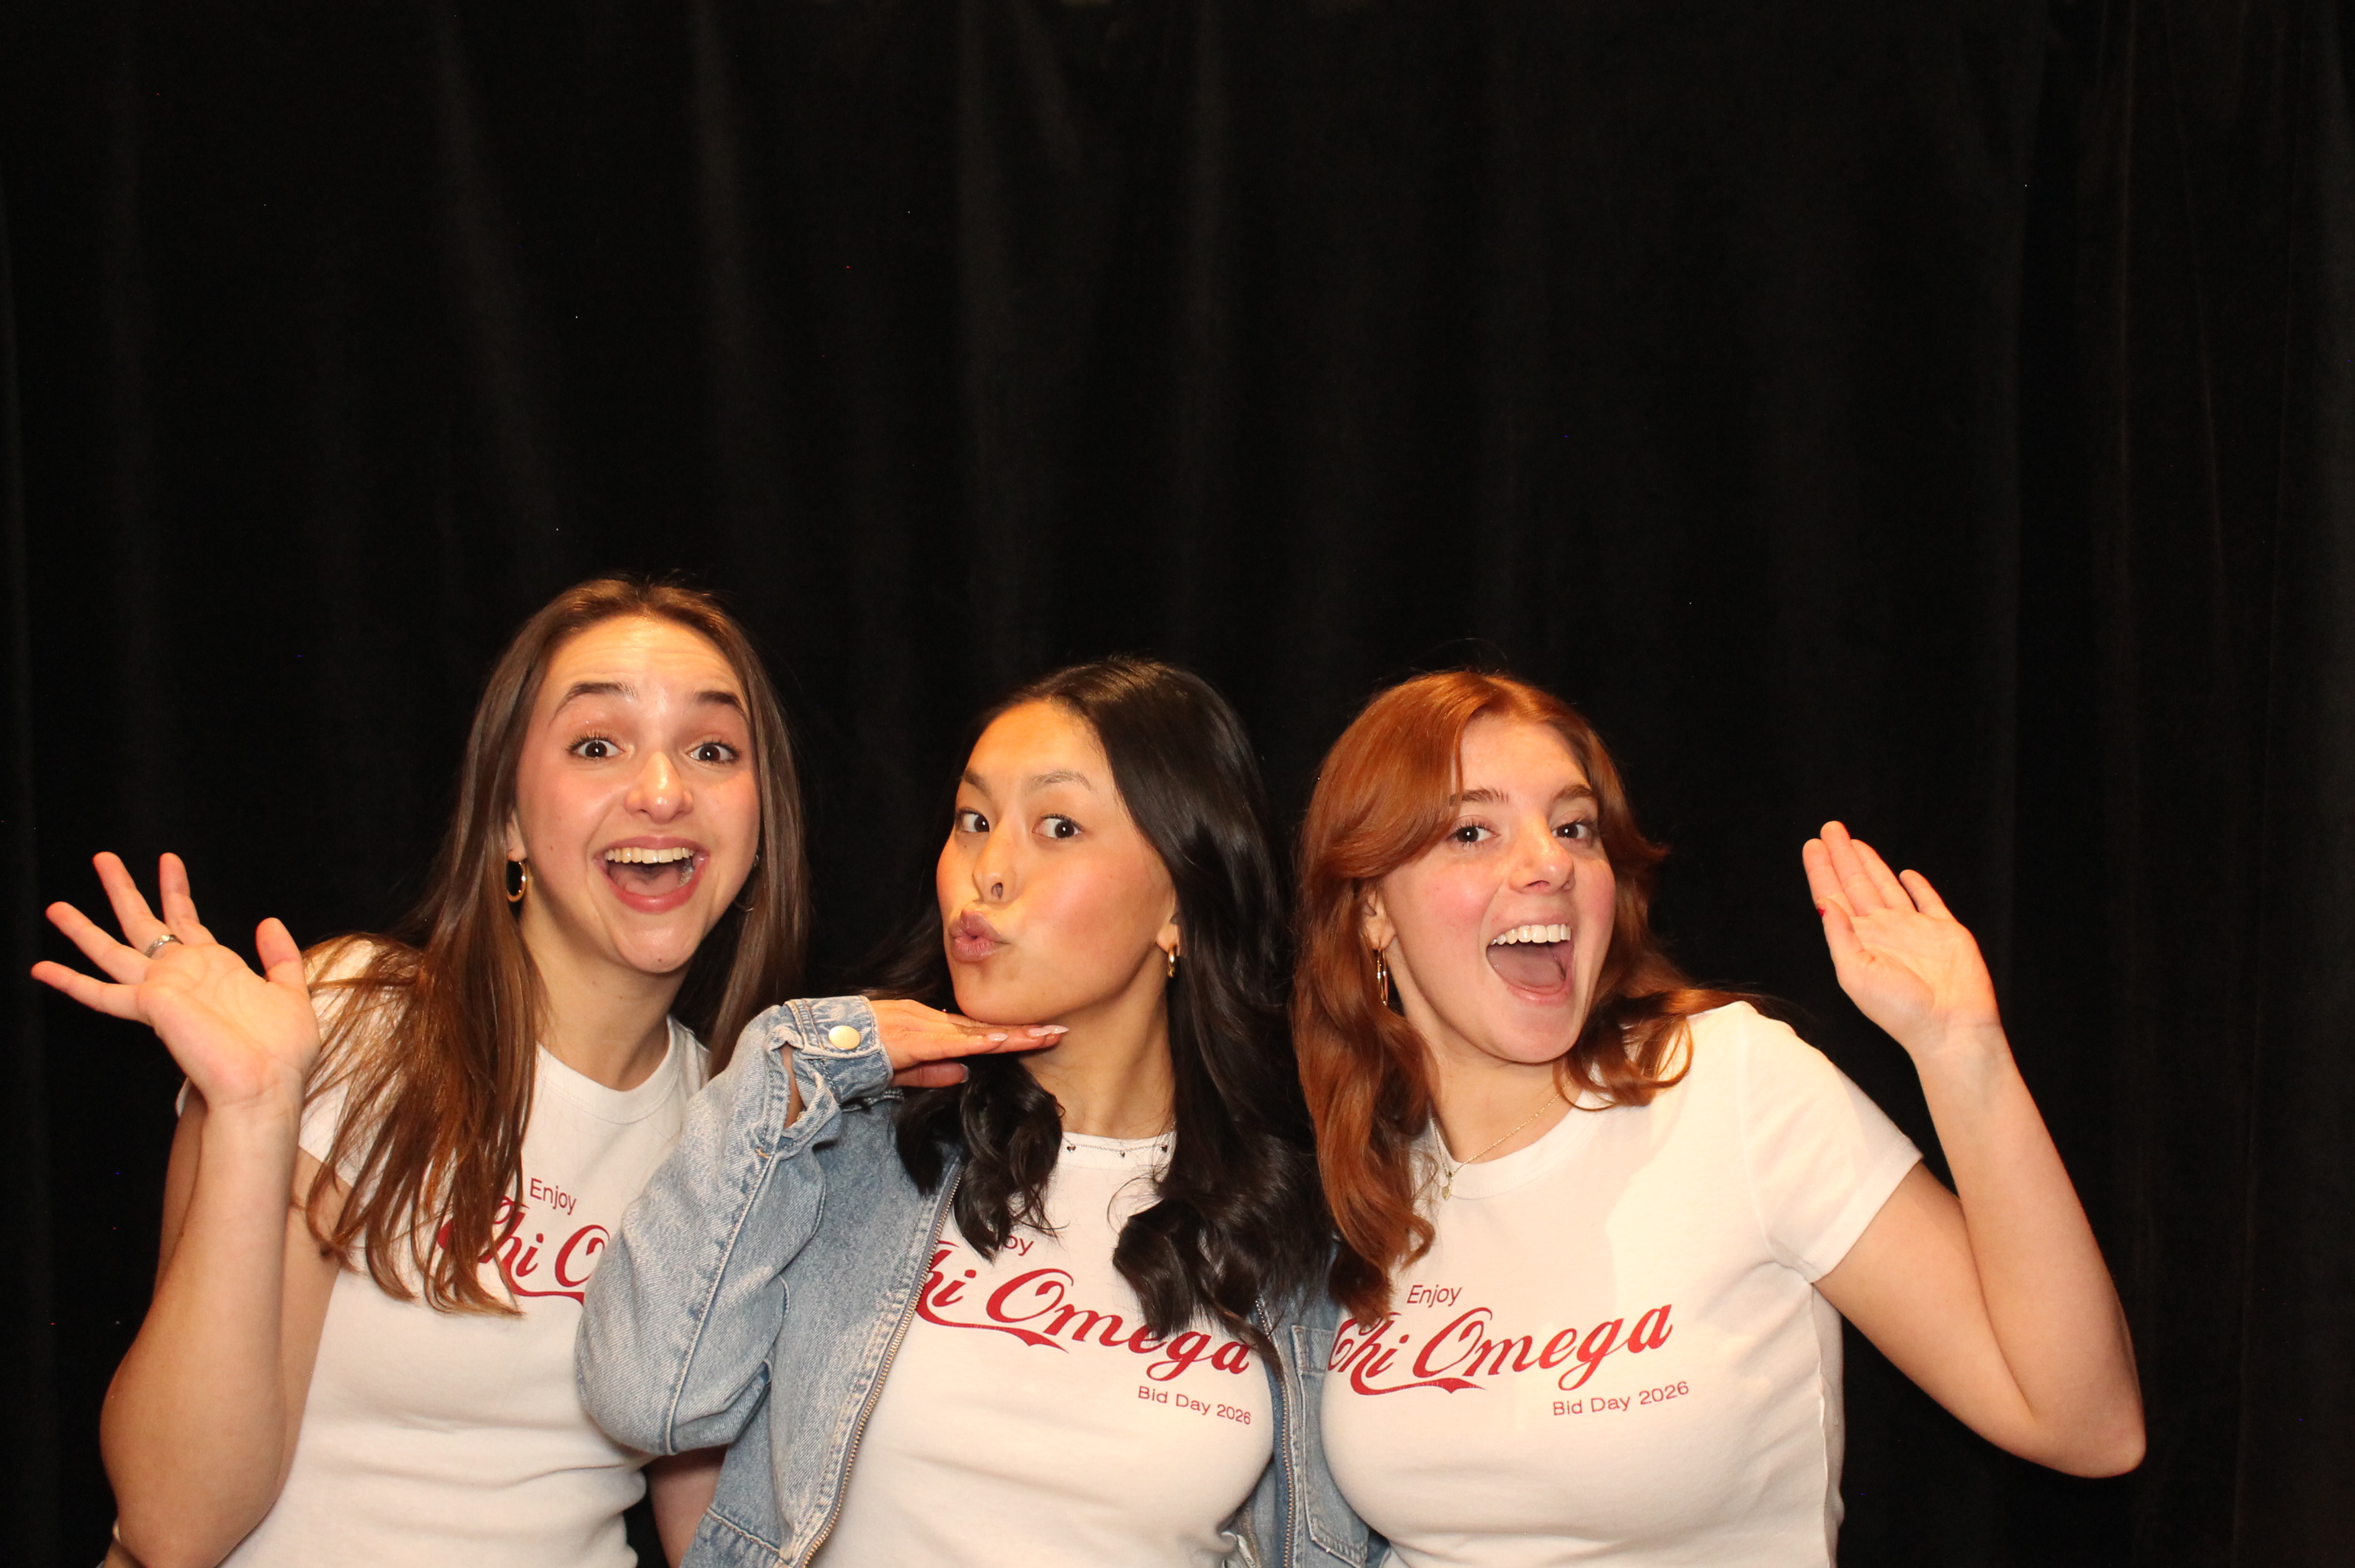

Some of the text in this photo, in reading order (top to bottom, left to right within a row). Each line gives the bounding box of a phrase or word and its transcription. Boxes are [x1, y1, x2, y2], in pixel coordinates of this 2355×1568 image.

[529, 1177, 577, 1216] Enjoy
[1406, 1284, 1463, 1308] Enjoy
[986, 1268, 1251, 1381] Omega
[1412, 1303, 1673, 1391] Omega
[1138, 1385, 1251, 1425] Bid Day 2026
[1553, 1380, 1689, 1416] Bid Day 2026
